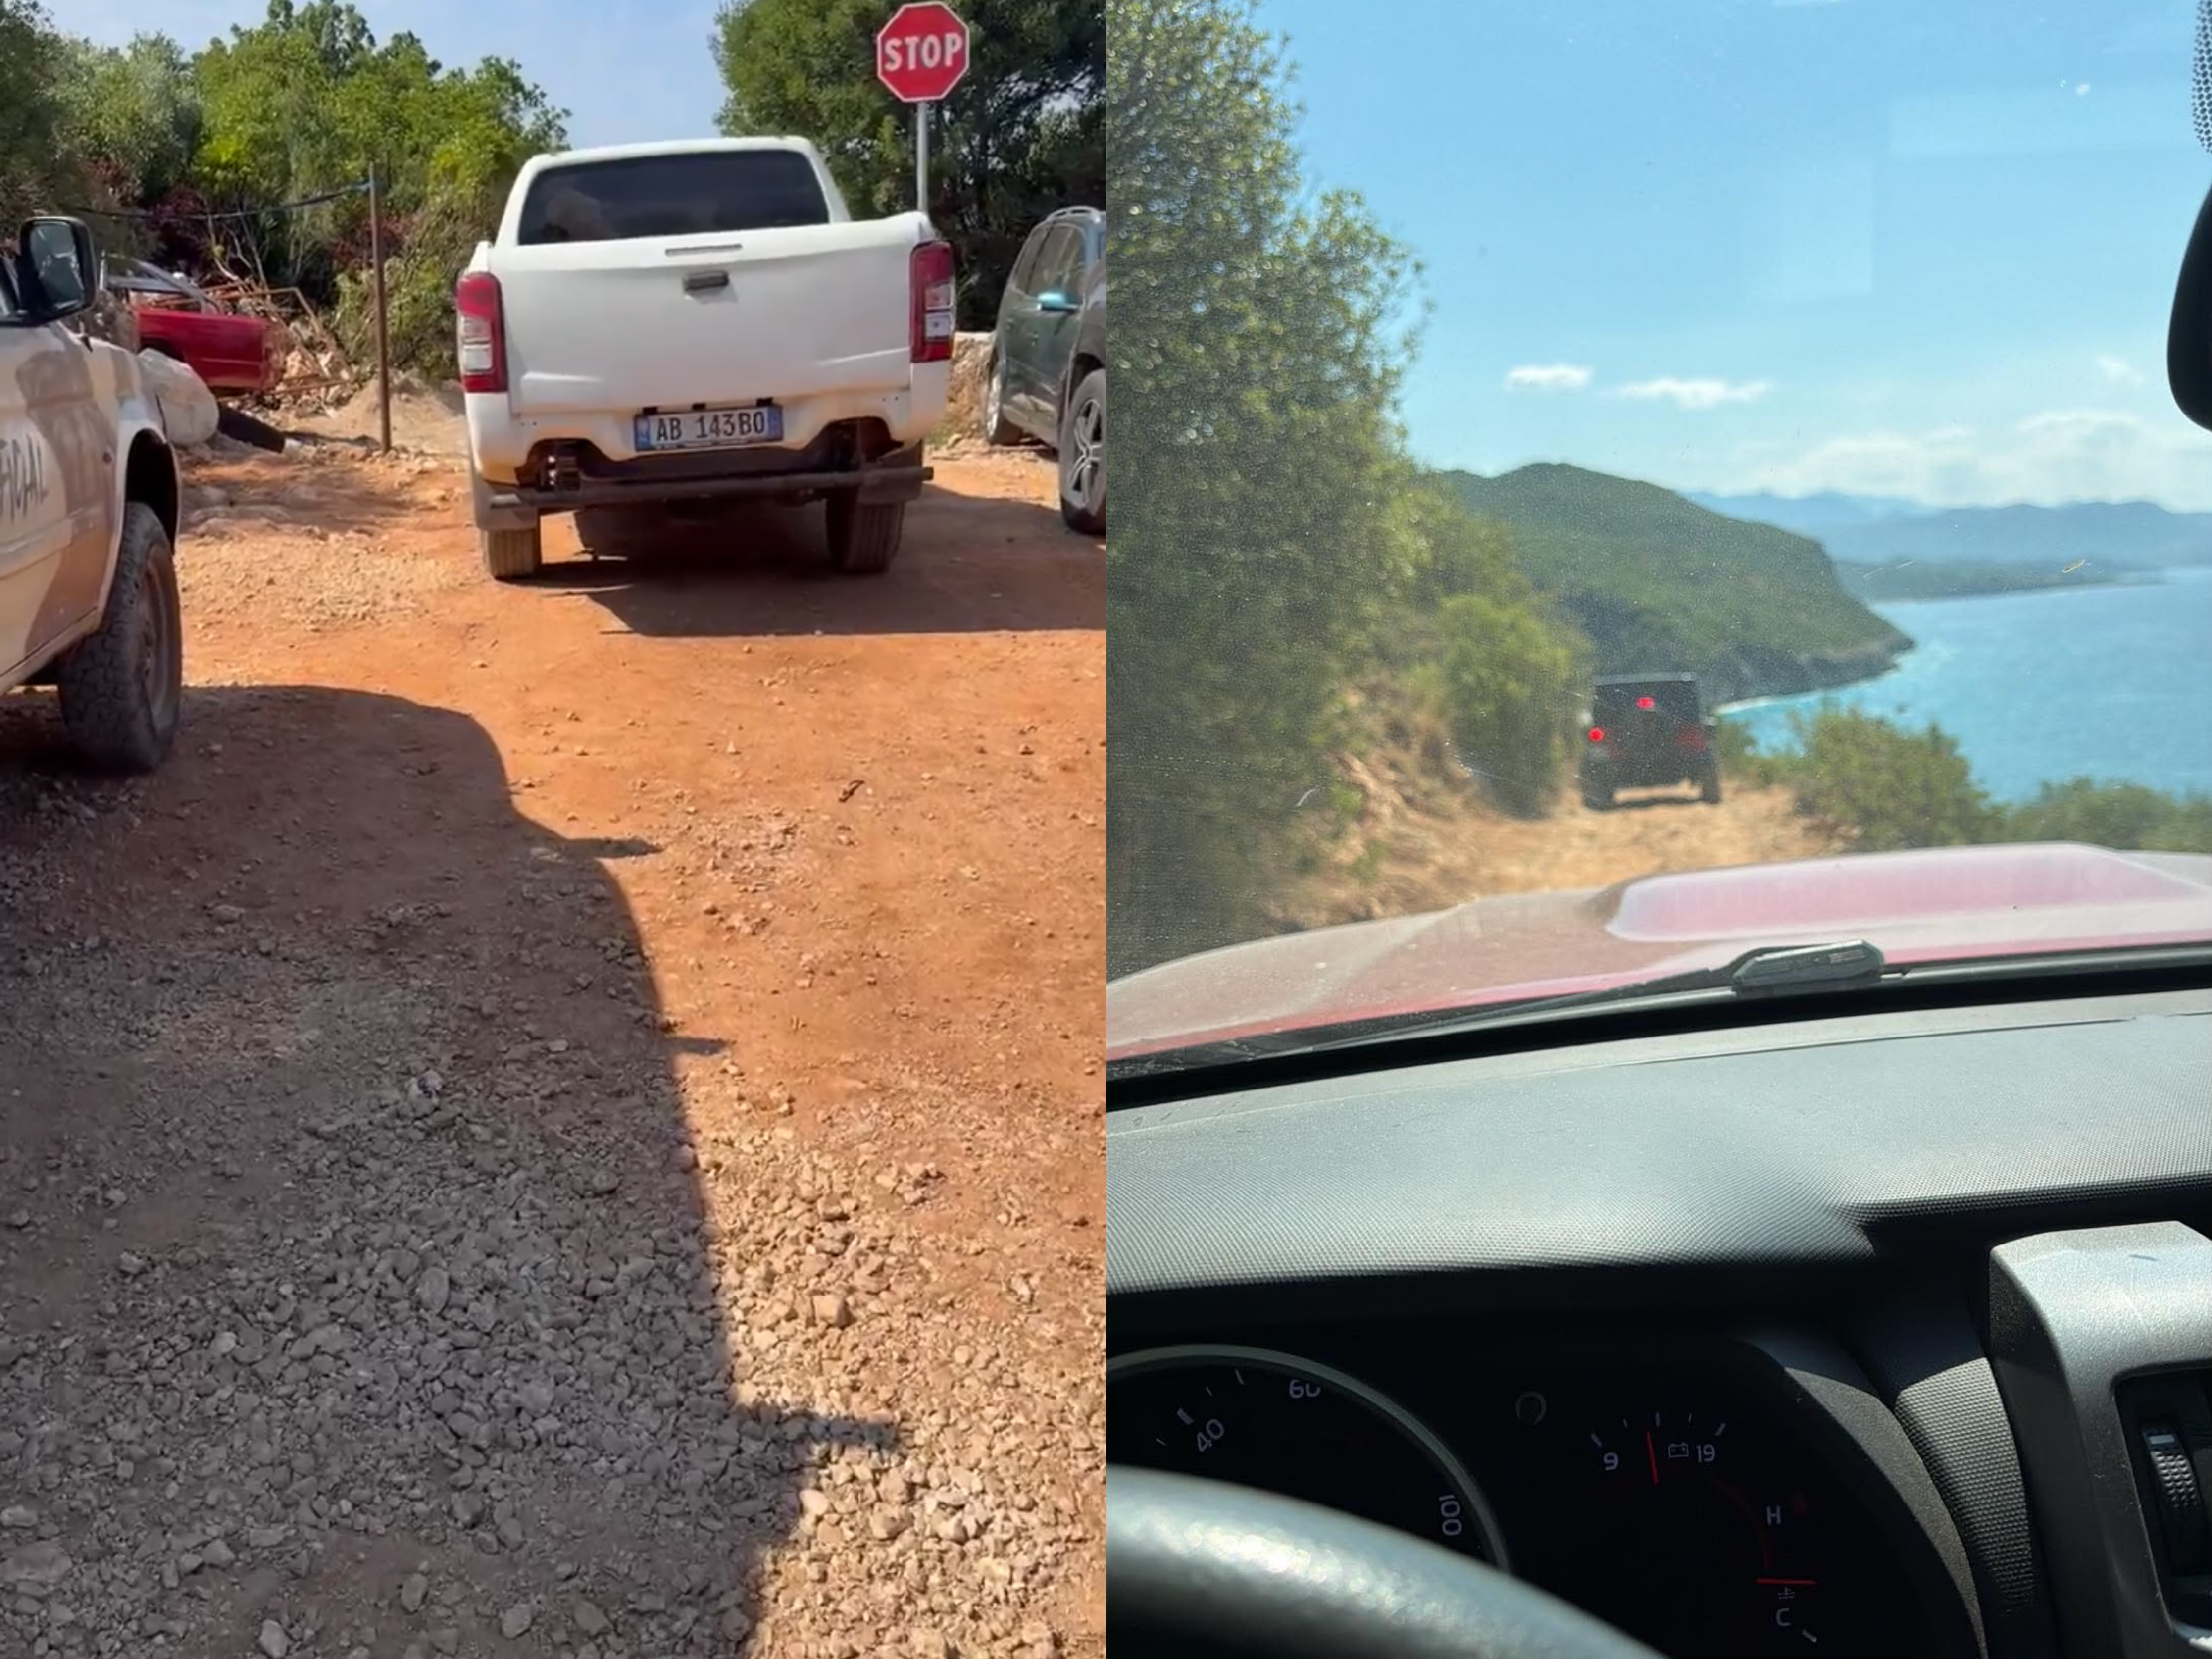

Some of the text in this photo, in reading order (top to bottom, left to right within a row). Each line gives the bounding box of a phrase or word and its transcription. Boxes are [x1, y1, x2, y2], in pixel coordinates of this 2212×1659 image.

[884, 33, 963, 71] STOP
[657, 417, 682, 440] AB
[1196, 1419, 1225, 1452] 40
[1604, 1452, 1619, 1470] 9
[1697, 1444, 1715, 1463] 19
[1438, 1495, 1462, 1537] 100
[1766, 1505, 1781, 1525] H
[1776, 1608, 1791, 1627] C
